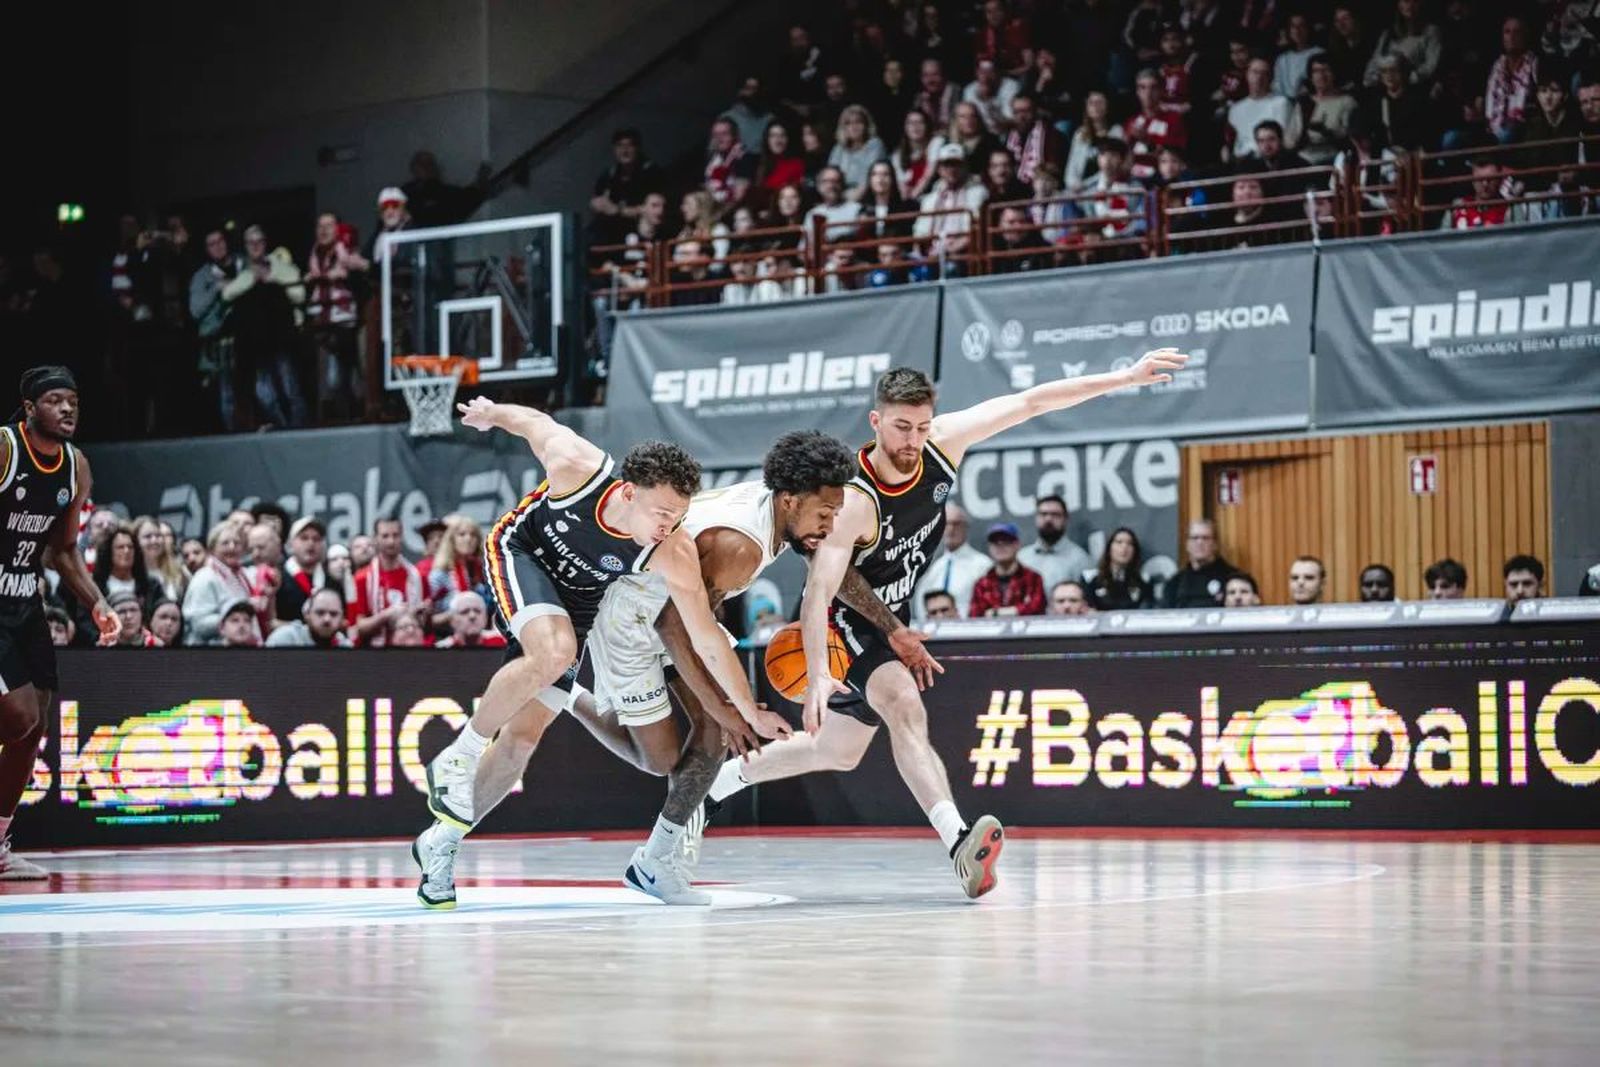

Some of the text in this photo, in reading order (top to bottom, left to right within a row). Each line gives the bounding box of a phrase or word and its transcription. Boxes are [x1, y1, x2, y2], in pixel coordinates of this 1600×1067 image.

[1194, 303, 1290, 333] SKODA
[1371, 281, 1600, 350] spindl
[652, 351, 891, 409] spindler
[951, 439, 1181, 519] ctake
[13, 540, 37, 567] 32
